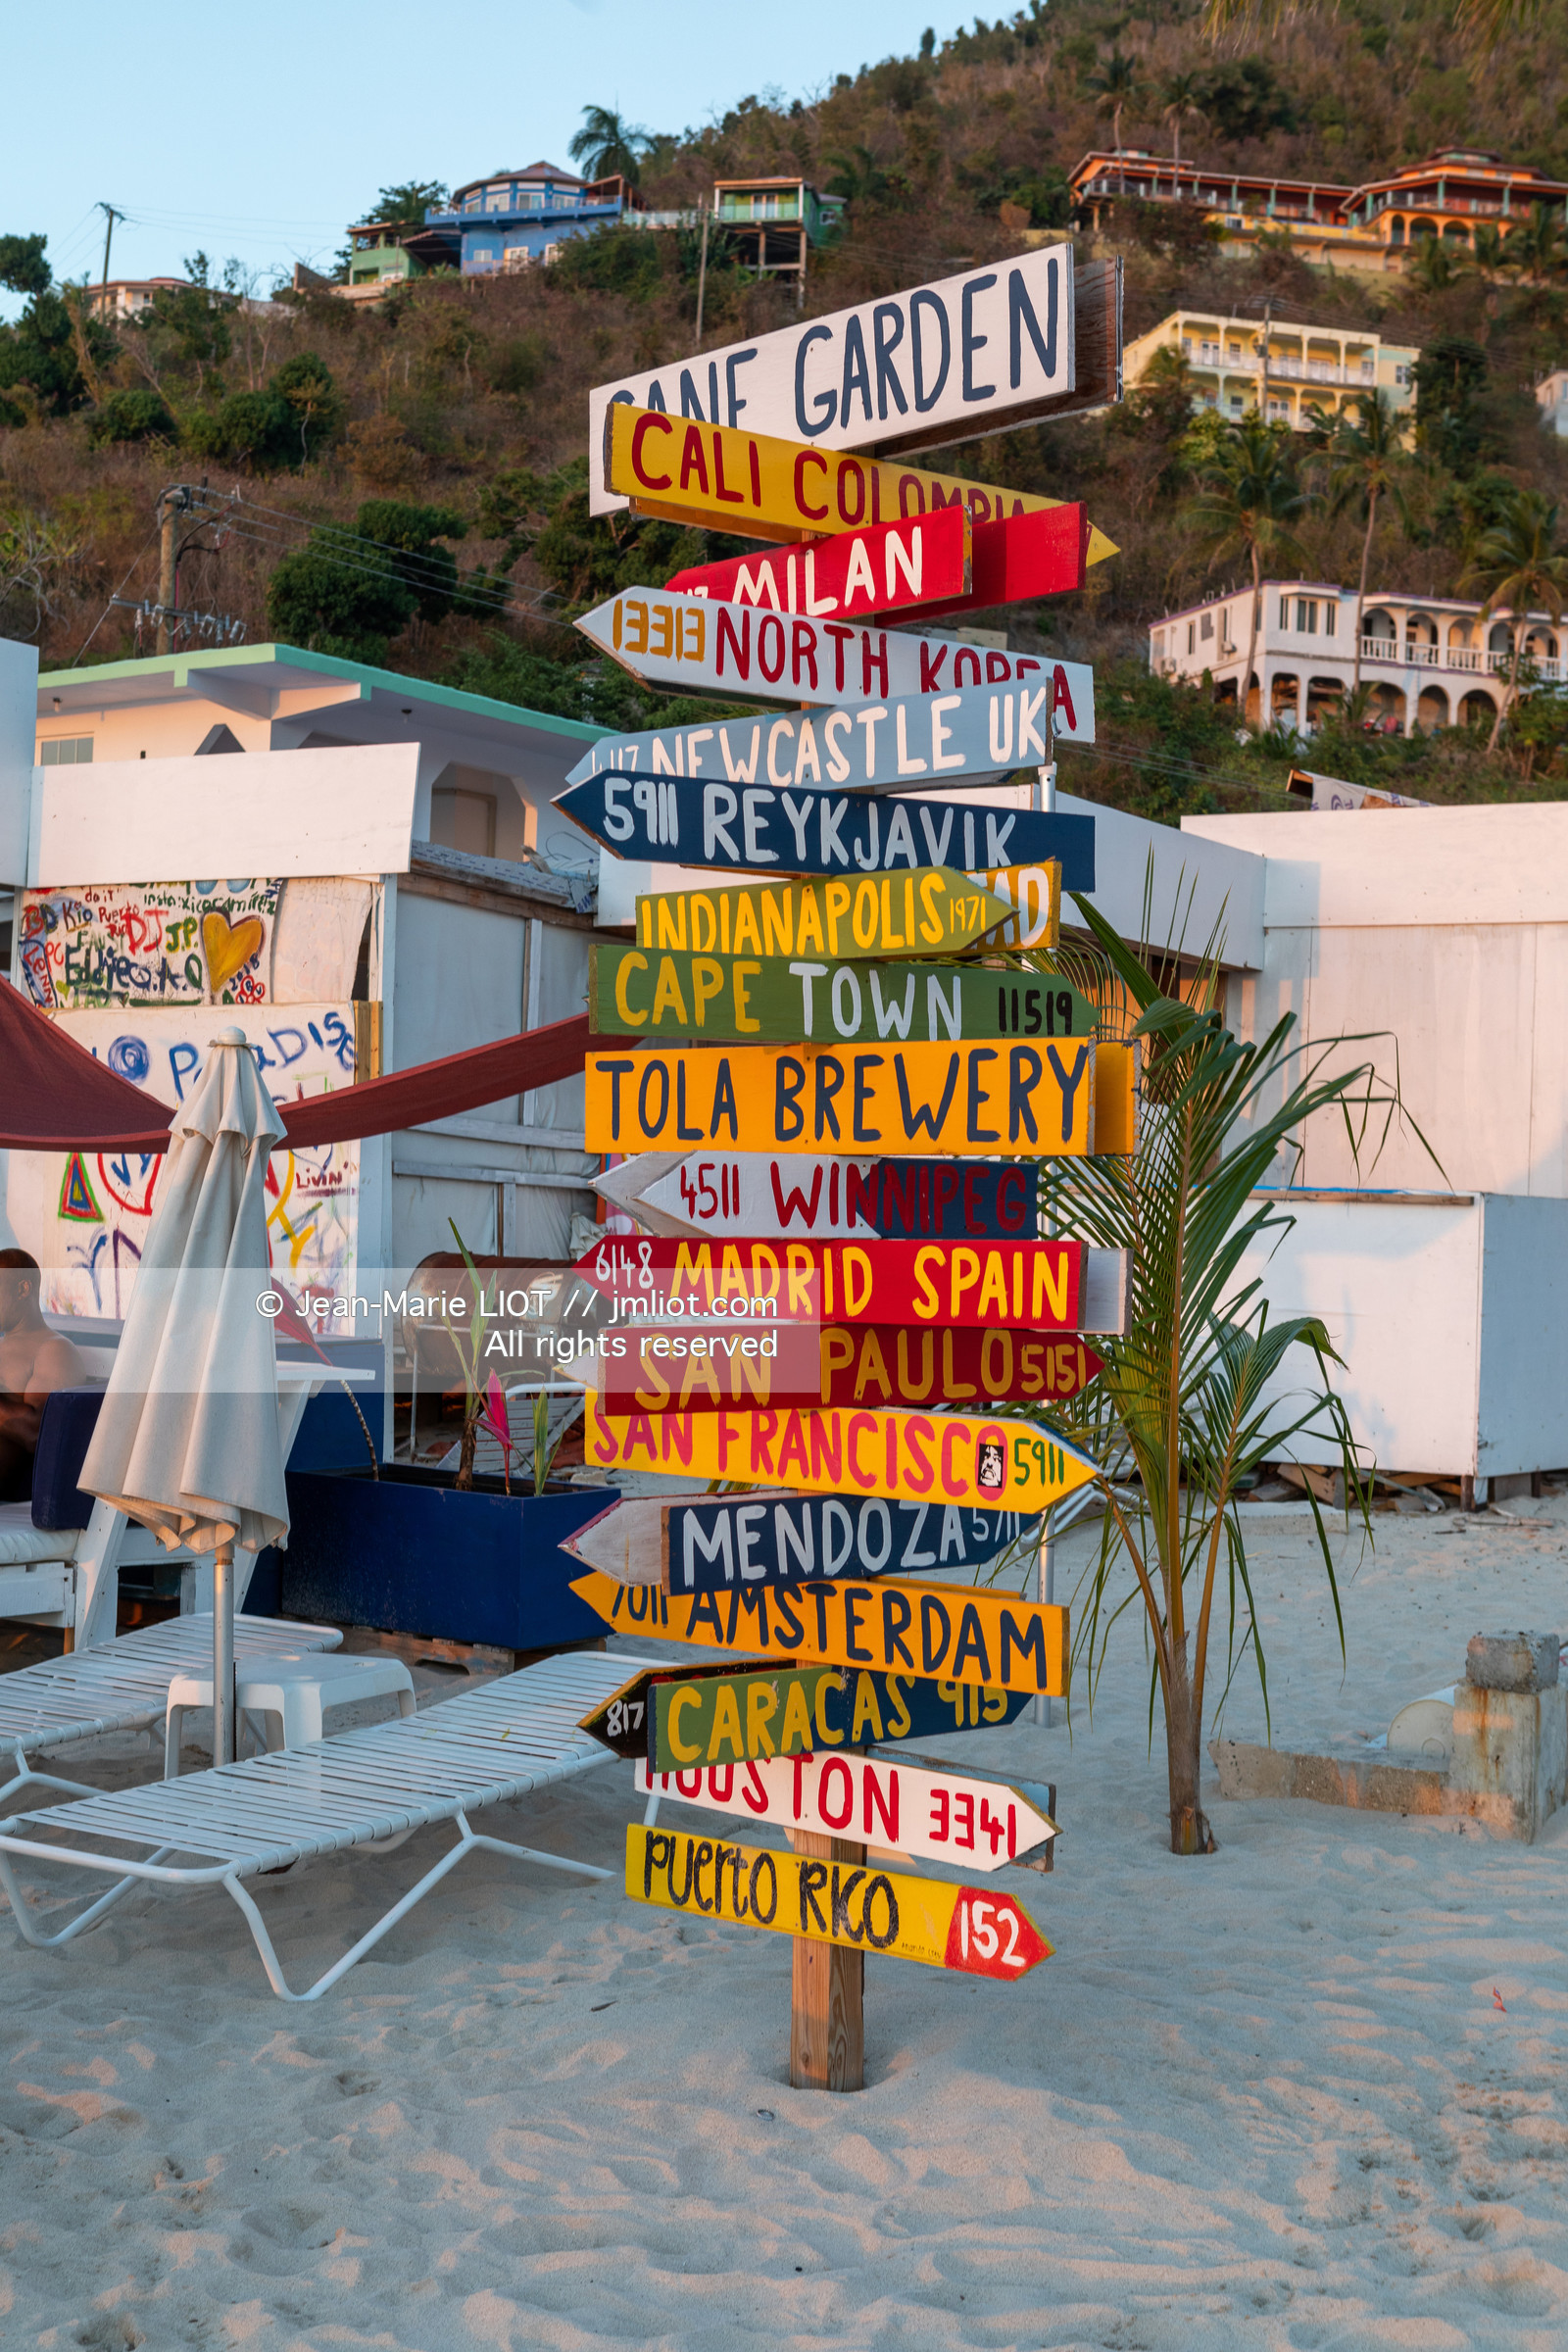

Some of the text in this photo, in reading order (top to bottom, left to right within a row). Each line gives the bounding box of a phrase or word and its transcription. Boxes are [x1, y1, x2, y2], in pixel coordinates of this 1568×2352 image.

[795, 259, 1058, 437] GARDEN
[631, 413, 761, 507] CALI
[732, 525, 922, 616] MILAN
[612, 599, 706, 662] 13313
[715, 607, 889, 699] NORTH
[653, 686, 1047, 787] NEWCASTLE UK
[603, 777, 1016, 871] 5911 REYKJAVIK
[641, 872, 986, 956] INDIANAPOLIS 1971
[615, 952, 1073, 1041] CAPE TOWN 11519
[595, 1045, 1089, 1144] TOLA BREWERY
[680, 1161, 1028, 1234] 4511 WINNIPEG
[595, 1241, 1068, 1321] 6148 MADRID SPAIN
[635, 1328, 1086, 1411] SAN PAULO 5151
[592, 1405, 1064, 1501] SAN FRANCISCO 5911
[684, 1497, 966, 1588] MENDOZA
[686, 1583, 1047, 1690] AMSTERDAM
[608, 1699, 644, 1738] 817
[667, 1672, 915, 1763] CARACAS
[929, 1788, 1016, 1859] 3341
[799, 1860, 900, 1949] RICO
[960, 1899, 1026, 1967] 152
